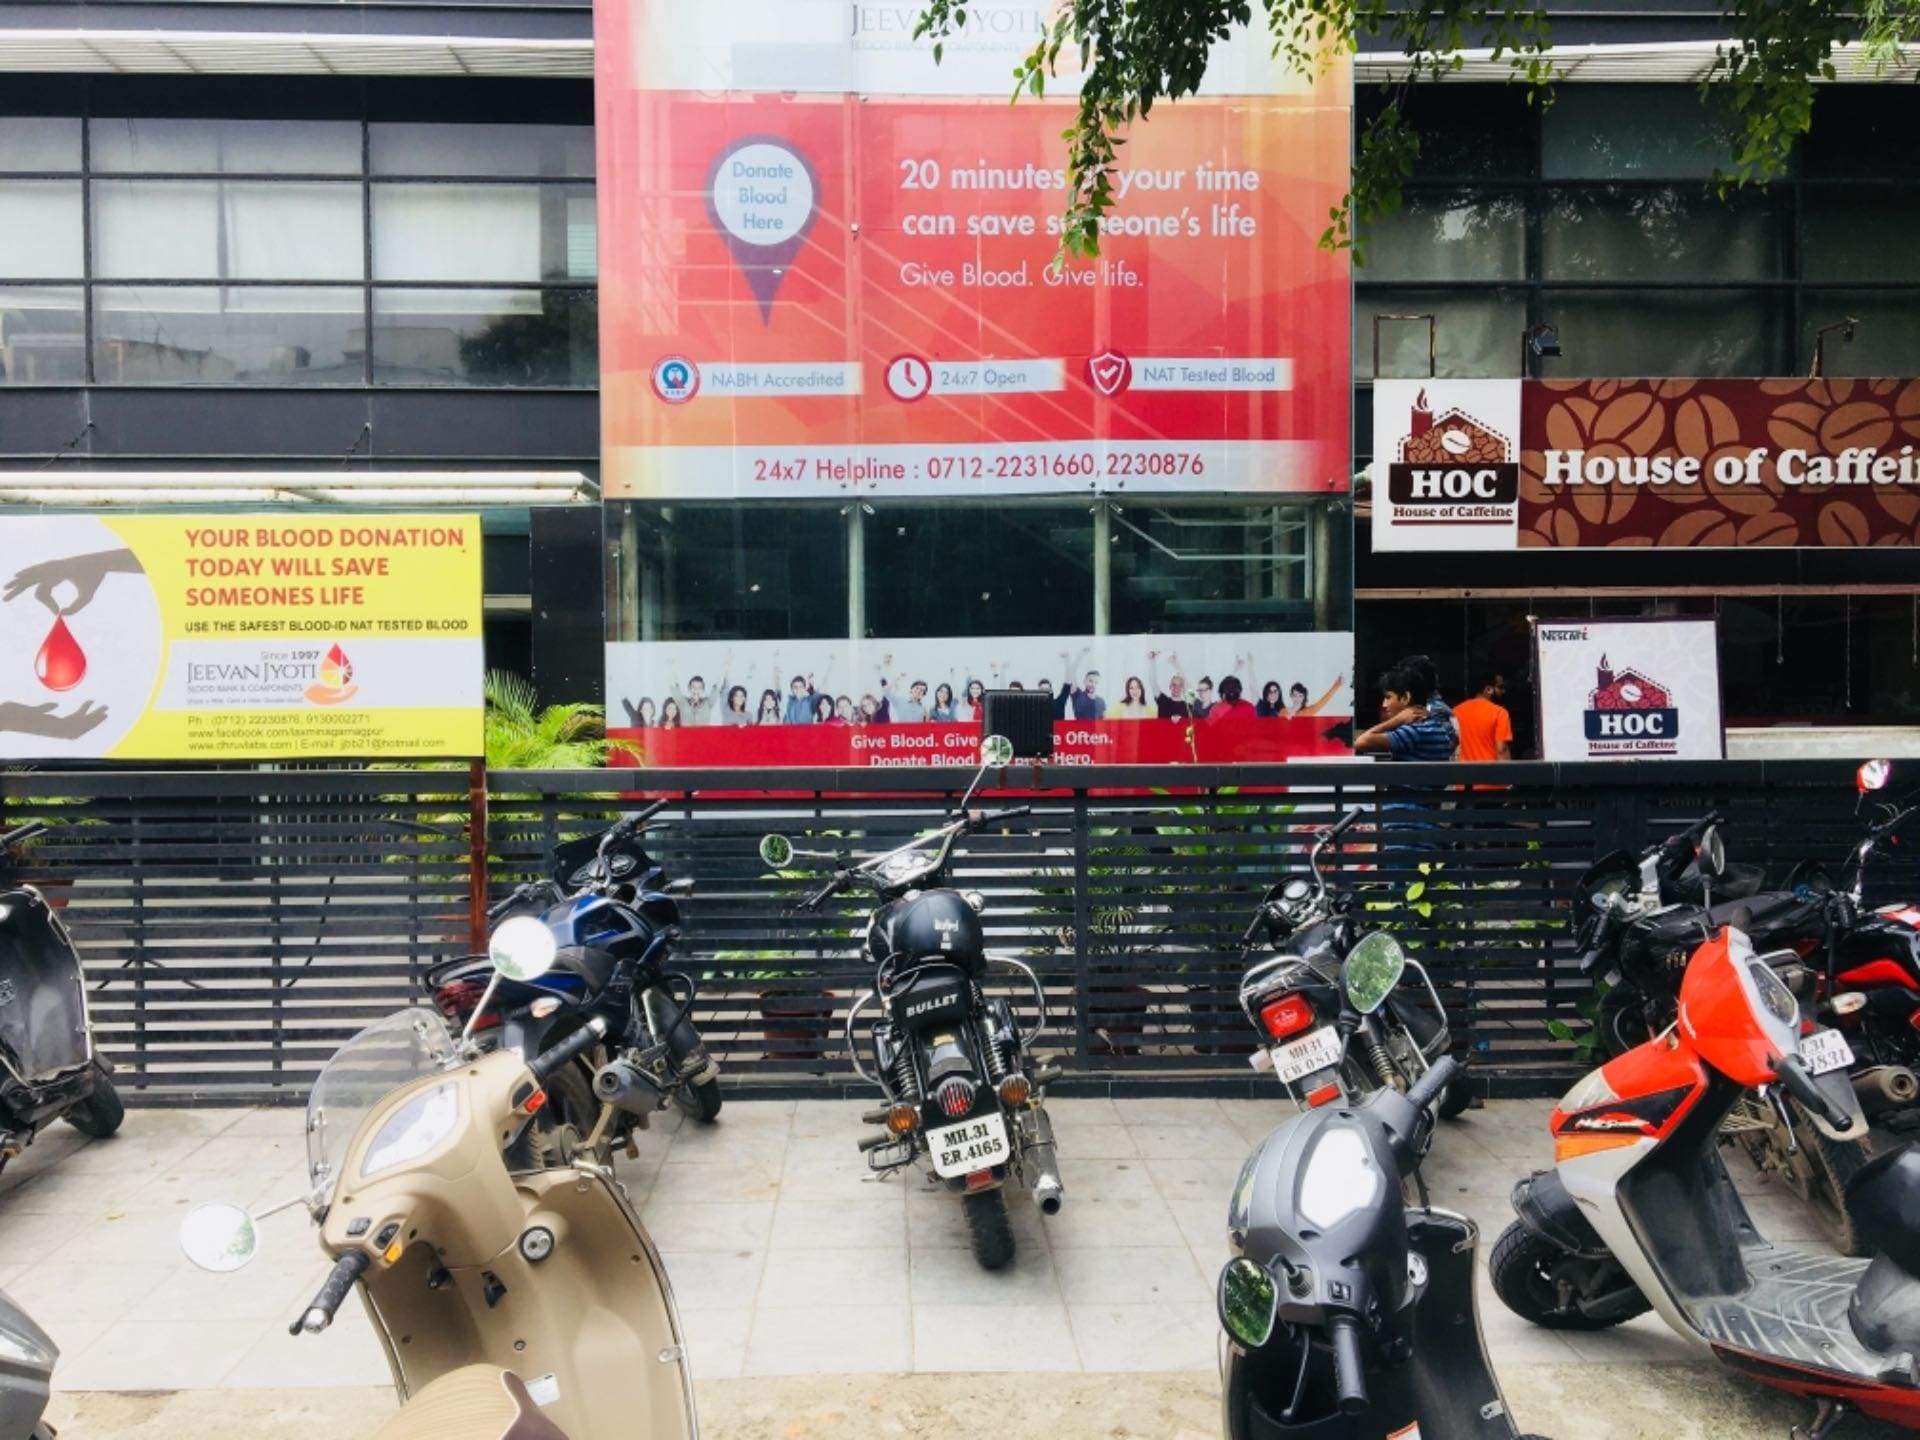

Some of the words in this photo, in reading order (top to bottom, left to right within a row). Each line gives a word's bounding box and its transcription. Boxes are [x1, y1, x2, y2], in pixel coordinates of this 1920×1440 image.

[852, 5, 957, 36] JEEV
[733, 161, 794, 179] Donate
[900, 159, 940, 190] 20
[951, 160, 1066, 190] minutes
[1116, 165, 1185, 199] your
[1195, 160, 1260, 191] time
[739, 186, 788, 204] Blood
[743, 212, 784, 230] Here
[902, 213, 956, 236] can
[966, 213, 1036, 236] save
[1045, 207, 1201, 237] seone's
[1210, 203, 1257, 236] life
[900, 262, 955, 287] Give
[963, 262, 1034, 287] Blood.
[1042, 263, 1097, 287] Give
[1104, 261, 1145, 288] life.
[712, 372, 759, 388] NABH
[763, 371, 845, 388] Accredited
[940, 370, 977, 386] 24x7
[983, 368, 1027, 389] Open
[1143, 367, 1177, 382] NAT
[1180, 367, 1228, 384] Tested
[1231, 366, 1276, 384] Blood
[754, 459, 807, 482] 24x7
[816, 457, 906, 485] Helpline
[1106, 452, 1204, 476] 2230876
[1543, 449, 1700, 485] House
[1714, 447, 1768, 486] of
[1777, 445, 1920, 486] Caffei
[1410, 468, 1498, 499] HOC
[1393, 506, 1437, 517] House
[1439, 506, 1454, 517] of
[1456, 506, 1513, 517] Caffeine
[185, 529, 250, 547] YOUR
[256, 529, 333, 547] BLOOD
[340, 529, 464, 547] DONATION
[186, 558, 264, 577] TODAY
[270, 558, 326, 576] WILL
[332, 557, 389, 576] SAVE
[186, 587, 314, 606] SOMEONES
[320, 587, 364, 605] LIFE
[185, 621, 208, 632] USE
[213, 621, 236, 631] THE
[239, 621, 285, 631] SAFEST
[289, 620, 347, 631] BLOOD-ID
[350, 620, 373, 630] NAT
[377, 620, 422, 630] TESTED
[426, 620, 468, 630] BLOOD
[260, 651, 288, 660] Since
[291, 650, 320, 659] 1997
[187, 662, 260, 683] JEEVAN
[264, 662, 317, 682] JYOTI
[1600, 713, 1664, 735] HOC
[851, 734, 886, 749] Give
[890, 733, 939, 747] Blood.
[944, 732, 978, 747] Give
[1065, 730, 1113, 746] Often.
[1589, 742, 1620, 750] House
[1635, 741, 1677, 749] Caffeine
[870, 754, 927, 767] Donate
[931, 753, 976, 766] Blood
[906, 994, 958, 1017] BULLET
